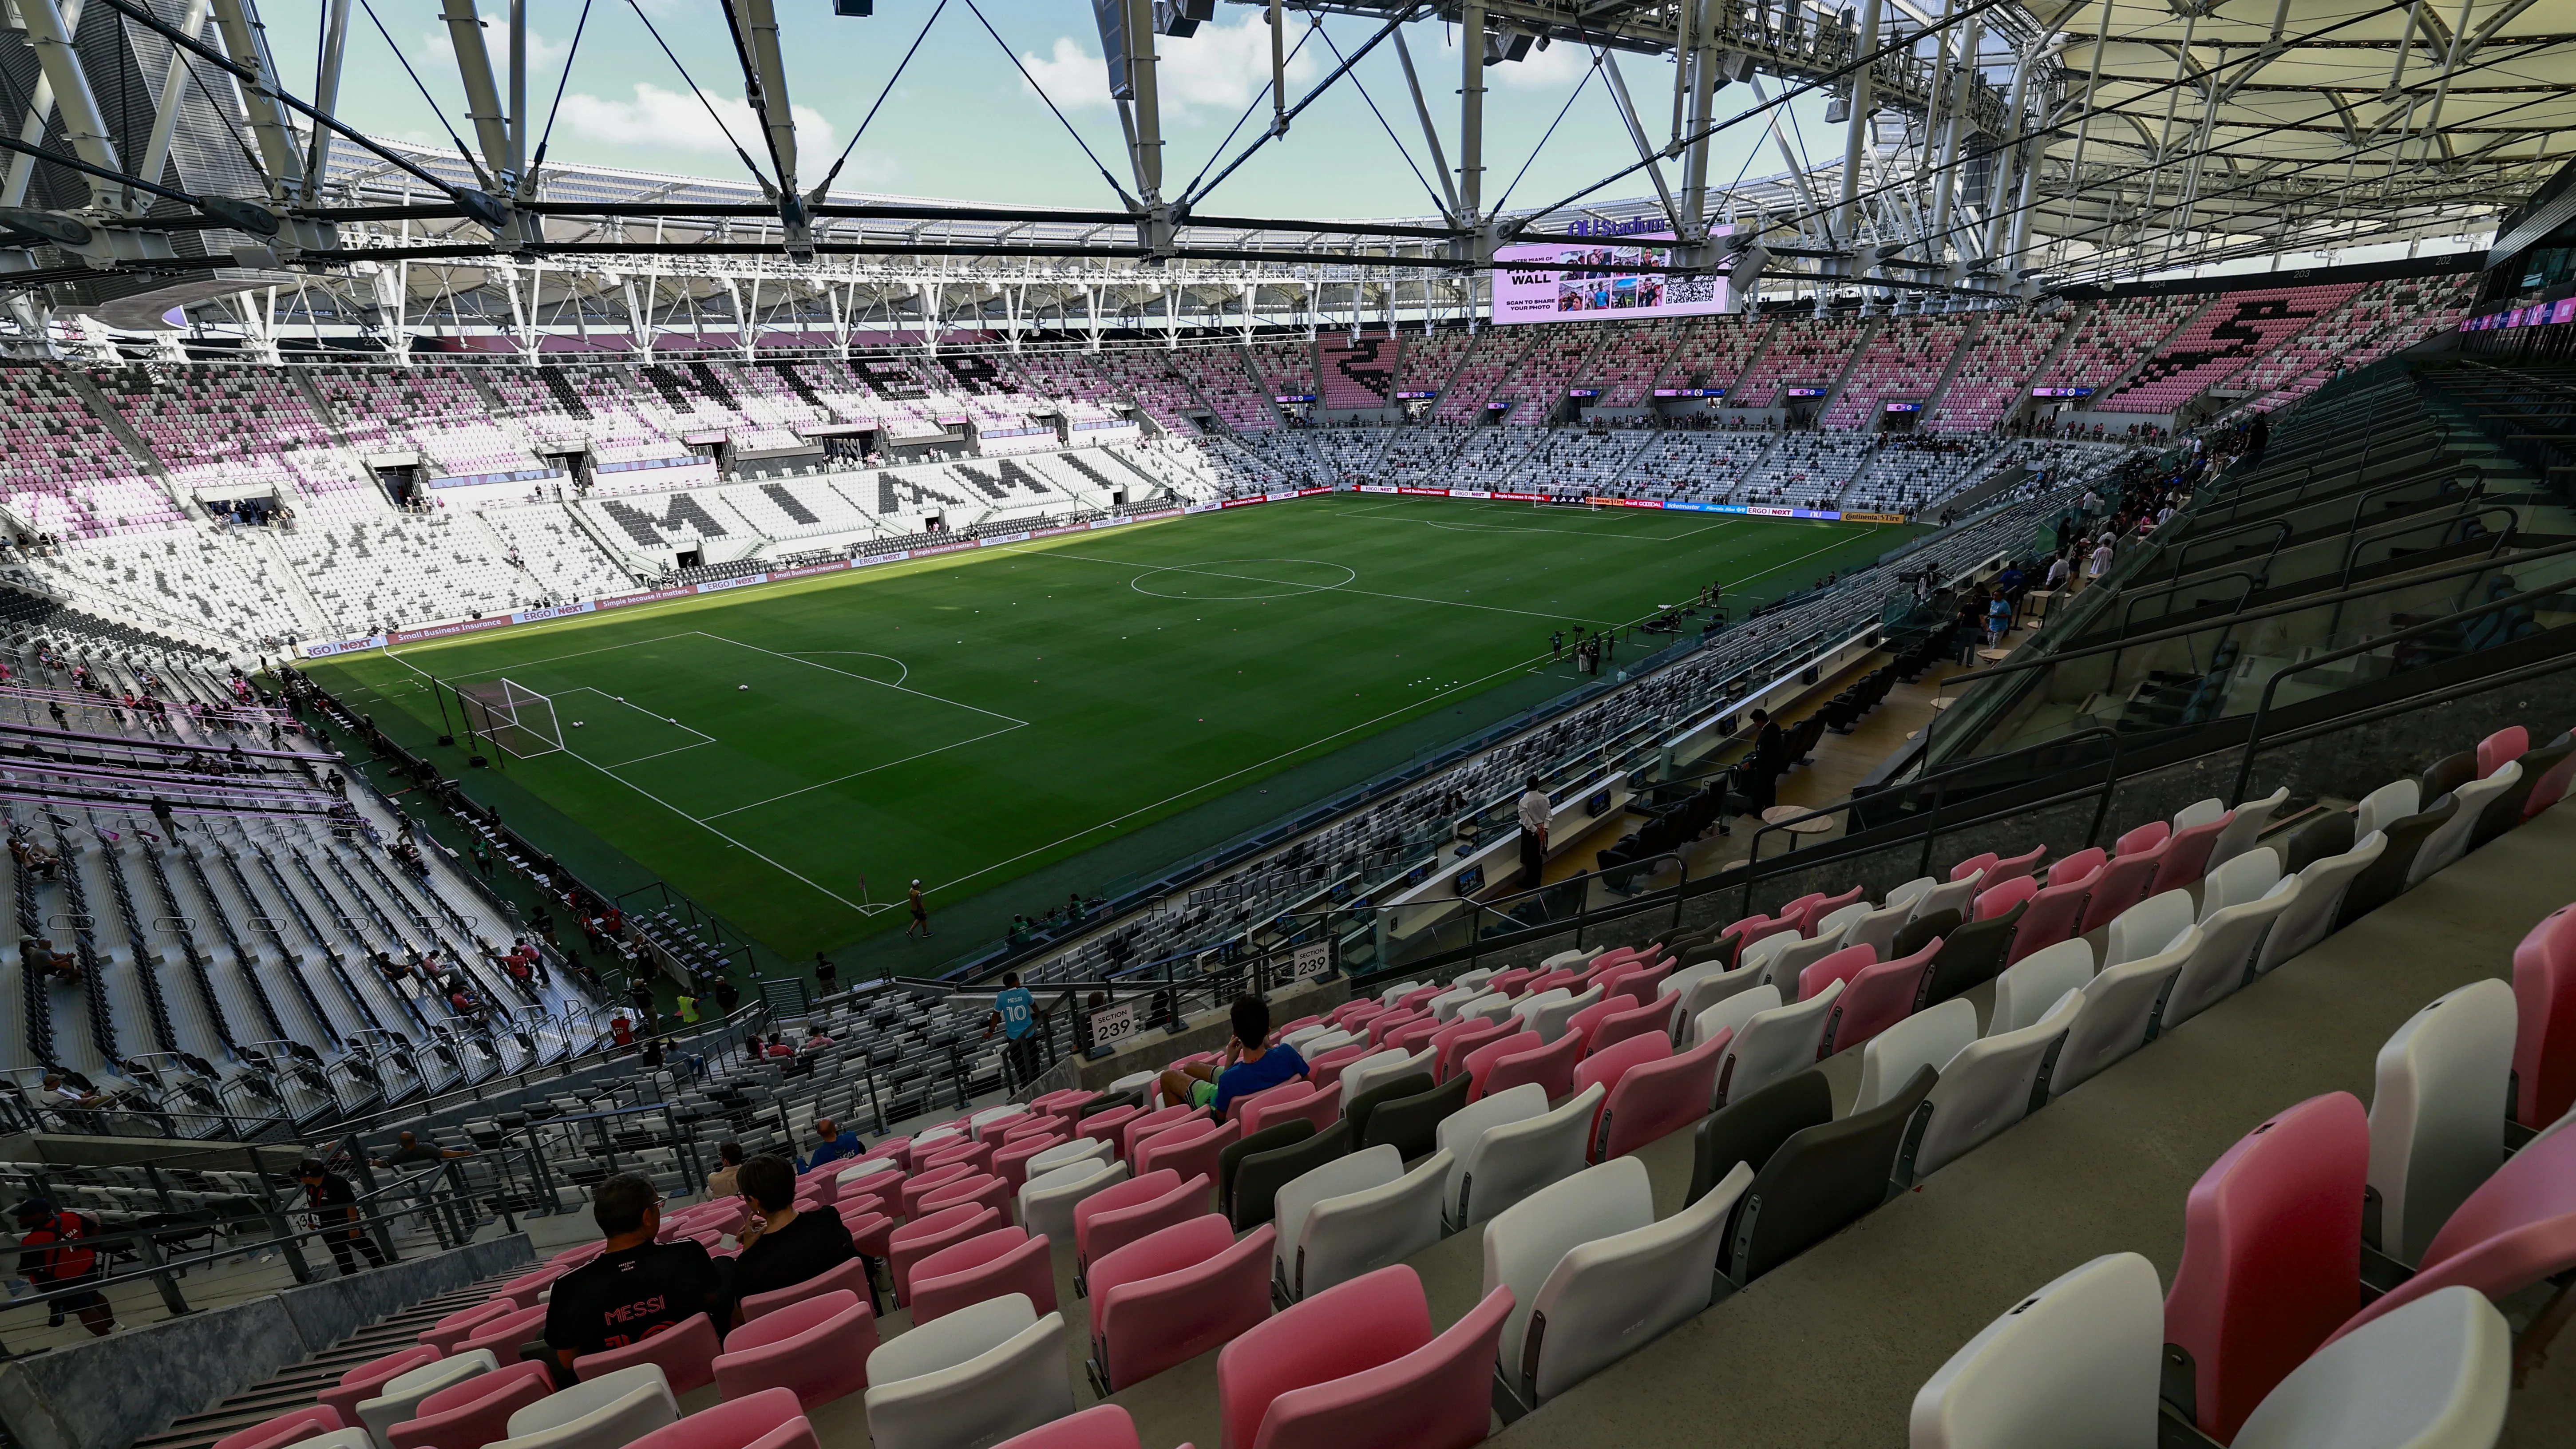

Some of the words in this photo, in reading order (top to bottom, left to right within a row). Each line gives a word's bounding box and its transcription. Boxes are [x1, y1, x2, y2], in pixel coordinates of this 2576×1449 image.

[1601, 216, 1665, 236] Stadium
[2435, 256, 2452, 265] 202
[1512, 274, 1551, 285] WALL
[2293, 270, 2310, 278] 203
[535, 355, 1018, 420] INTER
[982, 426, 1052, 439] MIAMI
[1074, 420, 1133, 431] MIAMI
[598, 456, 707, 473] MIAMI
[431, 469, 558, 488] MIAMI
[600, 453, 1113, 549] MIAMI
[859, 557, 878, 566] ERGO
[774, 571, 791, 579] Small
[817, 564, 844, 572] Insurance
[707, 581, 730, 590] ERGO
[603, 598, 626, 608] Simple
[627, 594, 655, 604] because
[662, 589, 690, 598] matters.
[523, 610, 551, 621] ERGO
[398, 631, 423, 641] Small
[424, 626, 460, 637] Business
[462, 619, 502, 630] Insurance
[1300, 948, 1325, 959] SECTION
[1299, 956, 1326, 976] 239
[1006, 1005, 1027, 1022] 10
[1098, 1010, 1128, 1024] SECTION
[1098, 1019, 1130, 1041] 239
[296, 1215, 308, 1231] 13
[605, 1295, 666, 1326] MESSI
